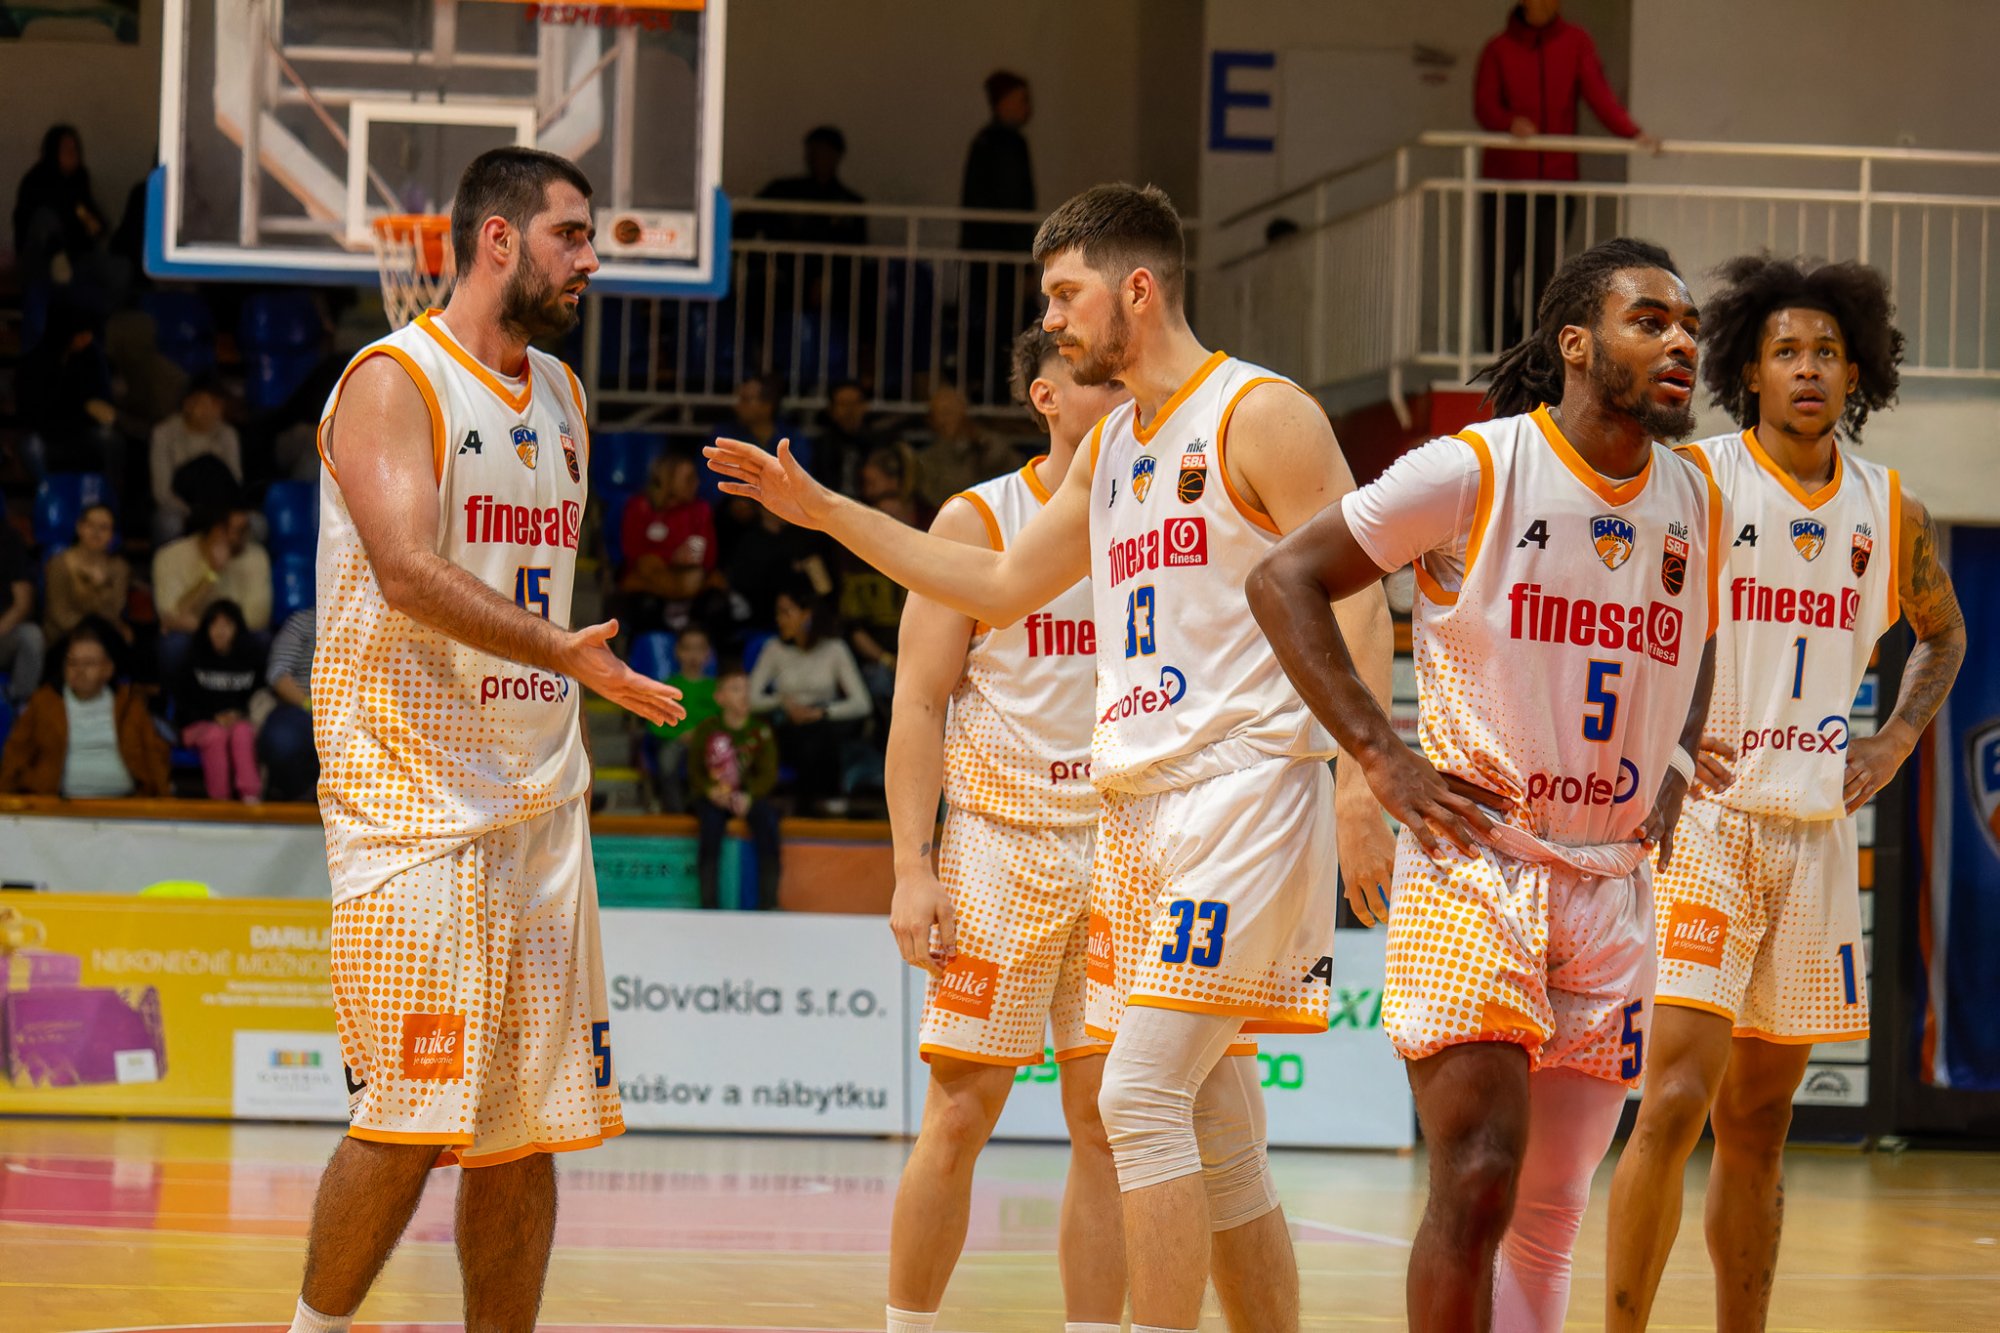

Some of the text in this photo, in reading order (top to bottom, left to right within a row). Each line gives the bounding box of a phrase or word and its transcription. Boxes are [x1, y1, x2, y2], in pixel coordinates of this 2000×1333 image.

[1208, 50, 1276, 153] E
[1182, 455, 1206, 468] SBL
[464, 495, 559, 547] finesa
[1594, 519, 1634, 545] BKM
[1668, 520, 1688, 540] niké
[1793, 521, 1825, 541] BKM
[1169, 552, 1202, 565] finesa
[1666, 538, 1687, 558] SBL
[1507, 583, 1644, 654] finesa
[1731, 577, 1835, 629] finesa
[1791, 634, 1808, 700] 1
[1582, 658, 1623, 743] 5
[1741, 721, 1846, 757] profex
[1160, 899, 1230, 969] 33
[1674, 919, 1720, 945] niké
[943, 970, 988, 998] niké
[1837, 942, 1857, 1005] 1
[611, 975, 887, 1019] Slovakia s.r.o.
[413, 1028, 456, 1054] niké
[1621, 997, 1643, 1081] 5
[723, 1083, 742, 1107] a
[752, 1078, 889, 1115] nábytku
